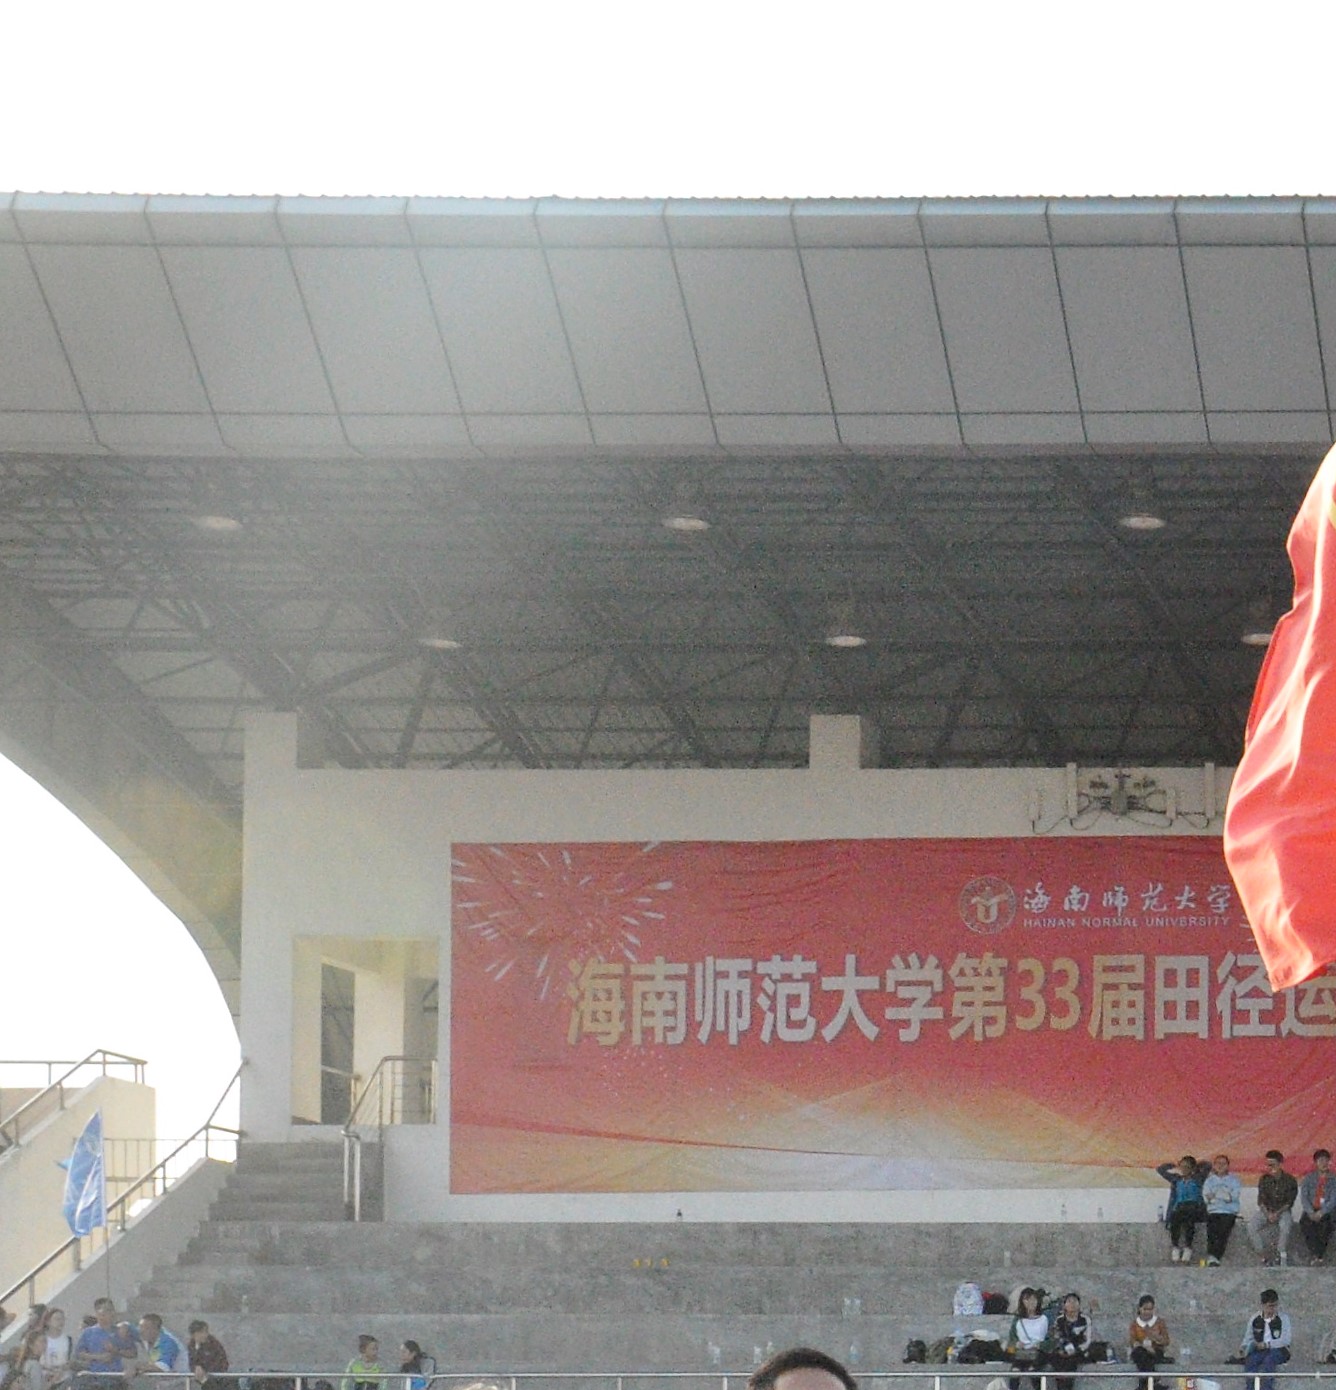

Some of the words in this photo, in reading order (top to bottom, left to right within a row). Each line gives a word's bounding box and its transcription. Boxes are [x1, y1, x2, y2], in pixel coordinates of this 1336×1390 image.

[1023, 881, 1231, 916] 海南师范大学
[1023, 917, 1075, 929] HAINAN
[1081, 917, 1138, 928] NORMAL
[1145, 916, 1231, 927] UNIVERSITY
